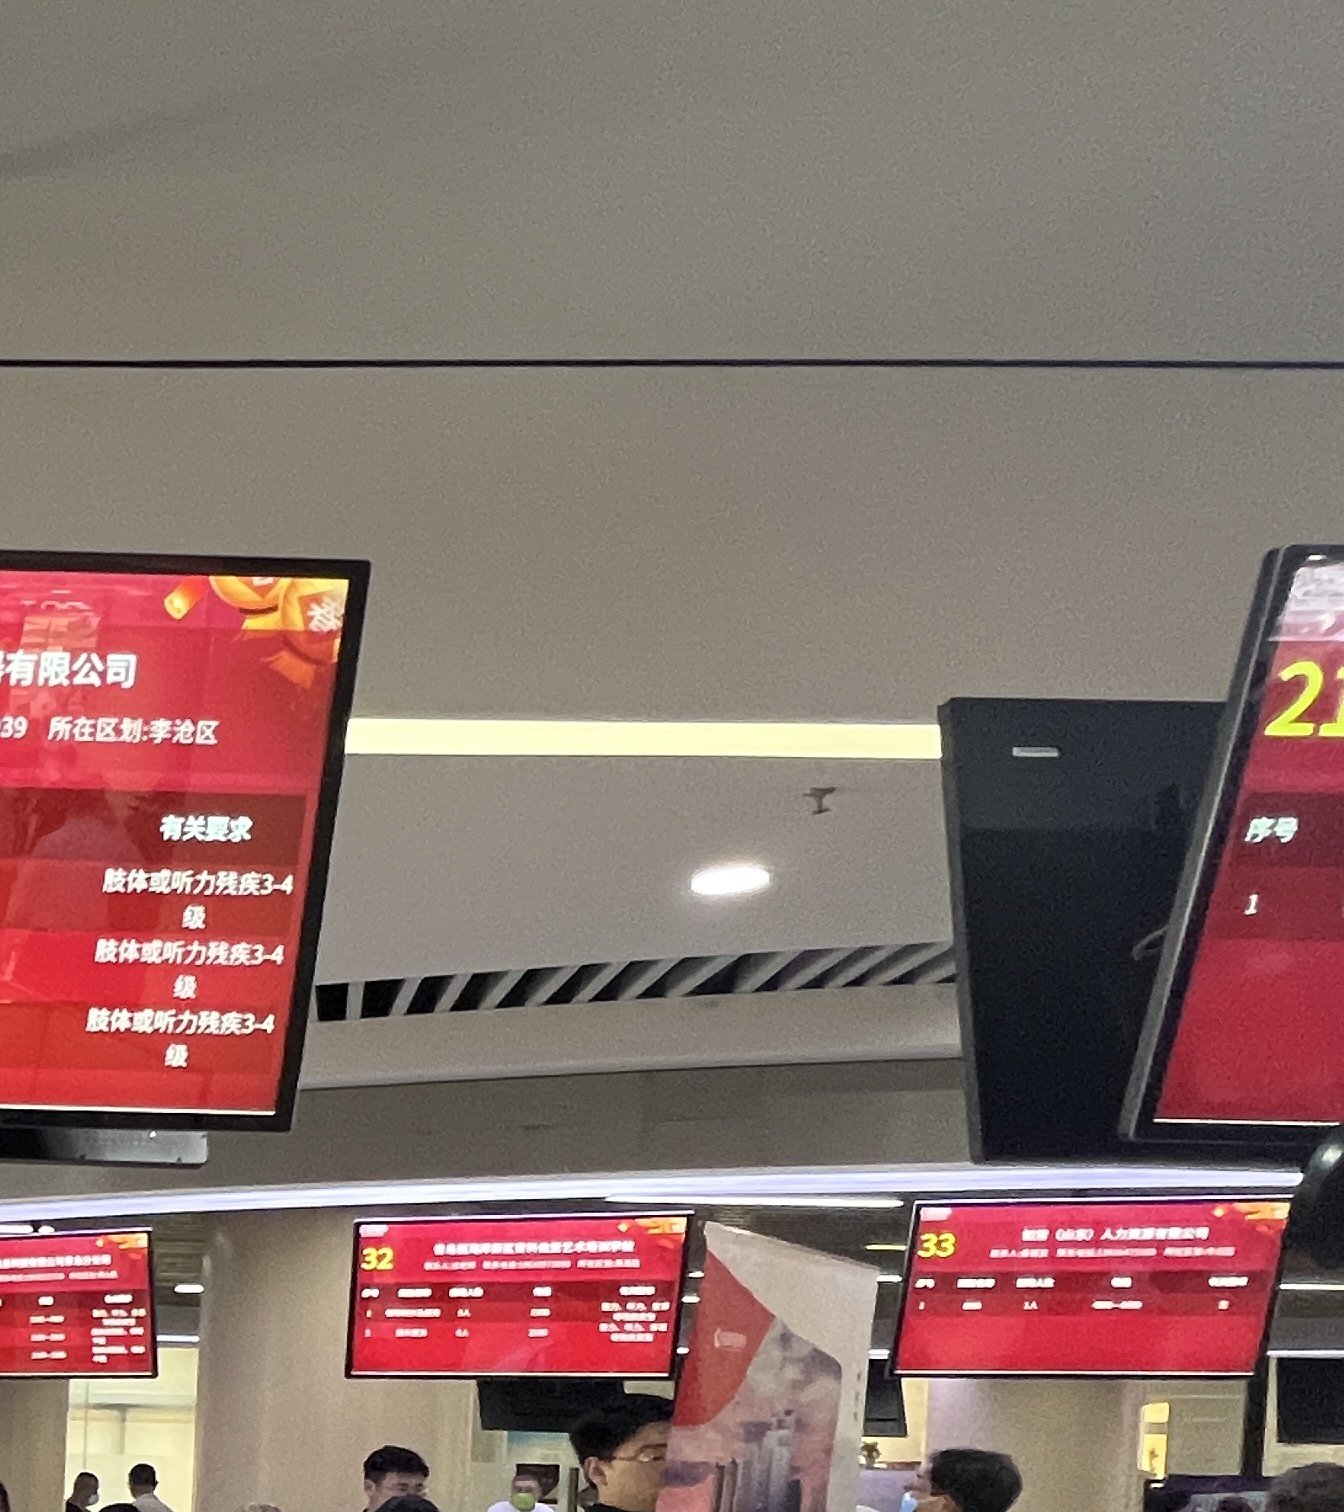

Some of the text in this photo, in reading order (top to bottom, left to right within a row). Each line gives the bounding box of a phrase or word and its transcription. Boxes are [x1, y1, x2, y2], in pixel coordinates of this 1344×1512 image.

[47, 716, 219, 745] 所在区划:李沧区
[159, 814, 253, 843] 有关要求
[1244, 816, 1298, 843] 序号
[102, 867, 294, 896] 肢体或听力残疾3-4
[181, 905, 206, 930] 级
[94, 938, 284, 966] 肢体或听力残疾3-4
[173, 974, 197, 999] 级
[85, 1007, 275, 1035] 肢体或听力残疾3-4
[164, 1043, 188, 1068] 级
[918, 1232, 957, 1258] 33
[361, 1247, 395, 1271] 32
